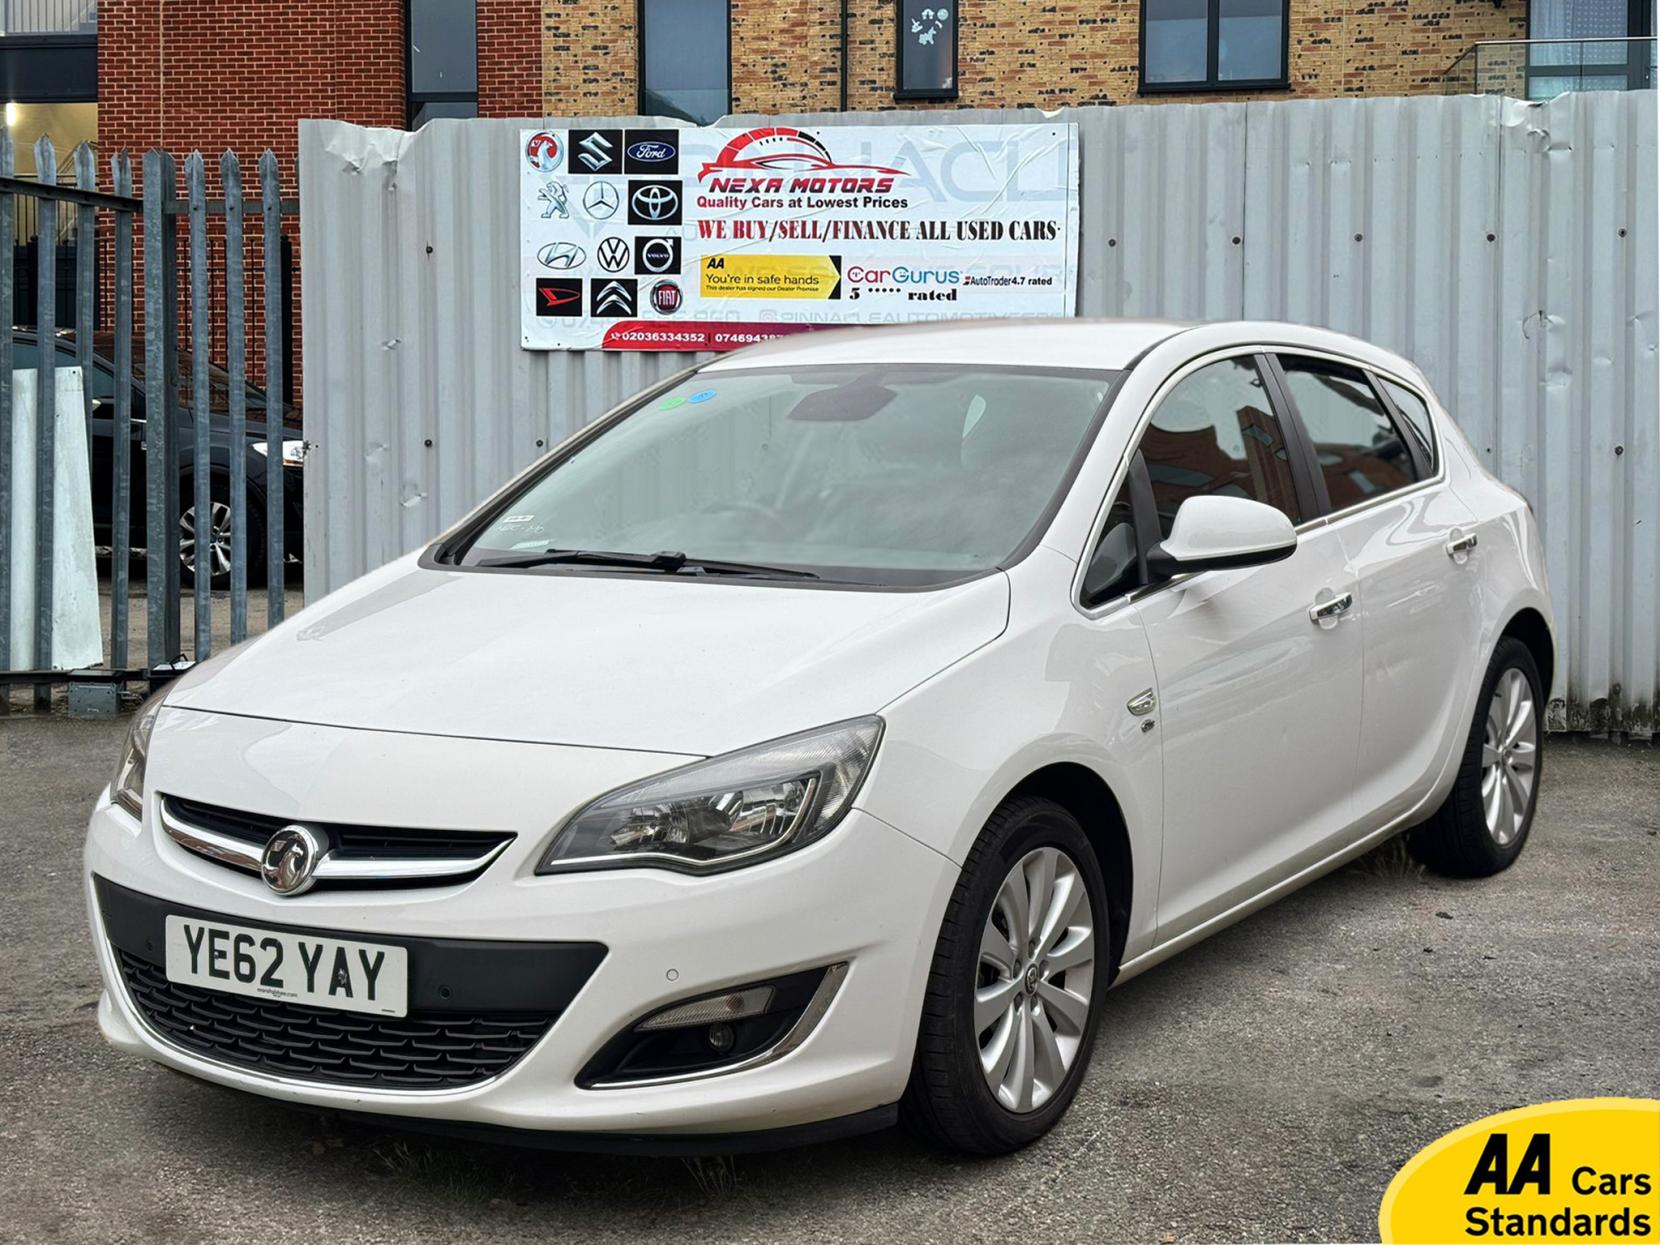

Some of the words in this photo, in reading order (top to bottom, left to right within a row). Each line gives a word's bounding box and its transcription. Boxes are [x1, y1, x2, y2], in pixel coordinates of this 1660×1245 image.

[636, 144, 667, 159] Ford
[708, 178, 784, 194] NEXA
[789, 178, 894, 194] MOTORS
[697, 196, 747, 210] Quality
[751, 196, 784, 208] Cars
[788, 197, 802, 208] at
[807, 196, 858, 208] Lowest
[863, 196, 908, 208] Prices
[697, 220, 727, 239] WE
[733, 219, 911, 242] BUY/SELL/FINANCE
[916, 220, 951, 240] ALL
[956, 220, 1004, 241] USED
[1008, 220, 1058, 241] CARS
[706, 257, 725, 269] AA
[705, 273, 741, 284] You're
[744, 273, 754, 284] in
[757, 274, 781, 284] safe
[784, 274, 820, 285] hands
[847, 266, 960, 284] CarGurus
[1011, 277, 1026, 286] 4.7
[1028, 277, 1053, 286] rated
[658, 290, 677, 306] FIAT
[849, 287, 861, 300] 5
[908, 288, 958, 301] rated
[622, 331, 705, 341] 02036334352
[183, 924, 284, 989] YE62
[297, 941, 386, 1001] YAY
